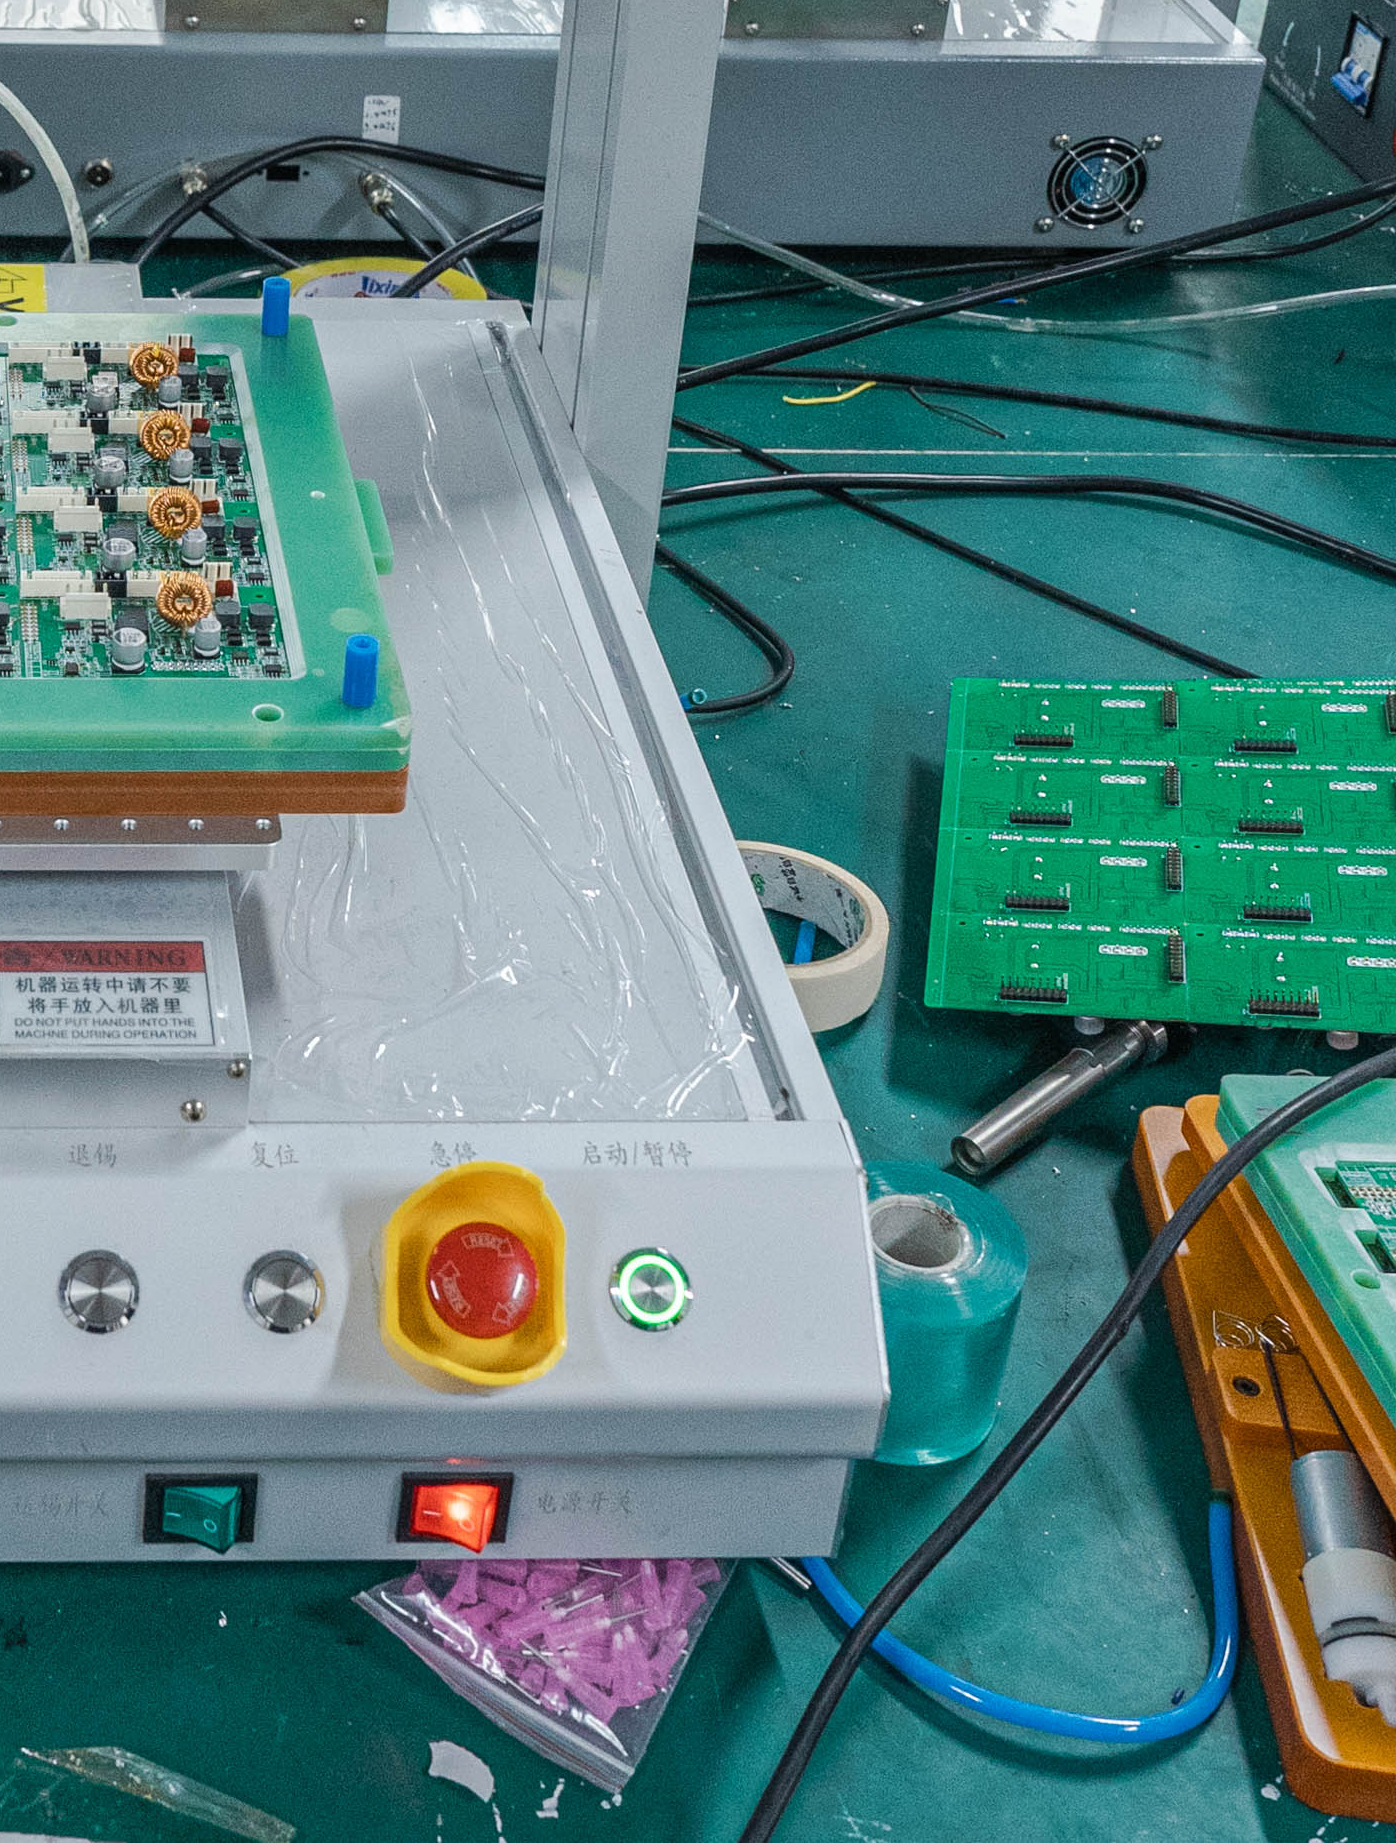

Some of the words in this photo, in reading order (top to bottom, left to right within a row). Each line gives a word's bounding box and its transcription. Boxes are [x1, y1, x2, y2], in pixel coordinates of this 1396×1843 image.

[15, 977, 192, 994] 机器运转中请不要
[28, 998, 183, 1014] 将手放入机器里
[15, 1017, 30, 1028] DO
[33, 1017, 61, 1028] NOT
[65, 1017, 89, 1028] PUT
[92, 1017, 134, 1028] HANDS
[138, 1017, 166, 1028] INTO
[170, 1017, 196, 1028] THE
[71, 1029, 120, 1040] DURING
[124, 1029, 197, 1040] OPERATION
[68, 1141, 117, 1168] 退锡
[250, 1141, 299, 1168] 复位
[429, 1141, 477, 1167] 急停
[537, 1490, 634, 1516] 电源开关
